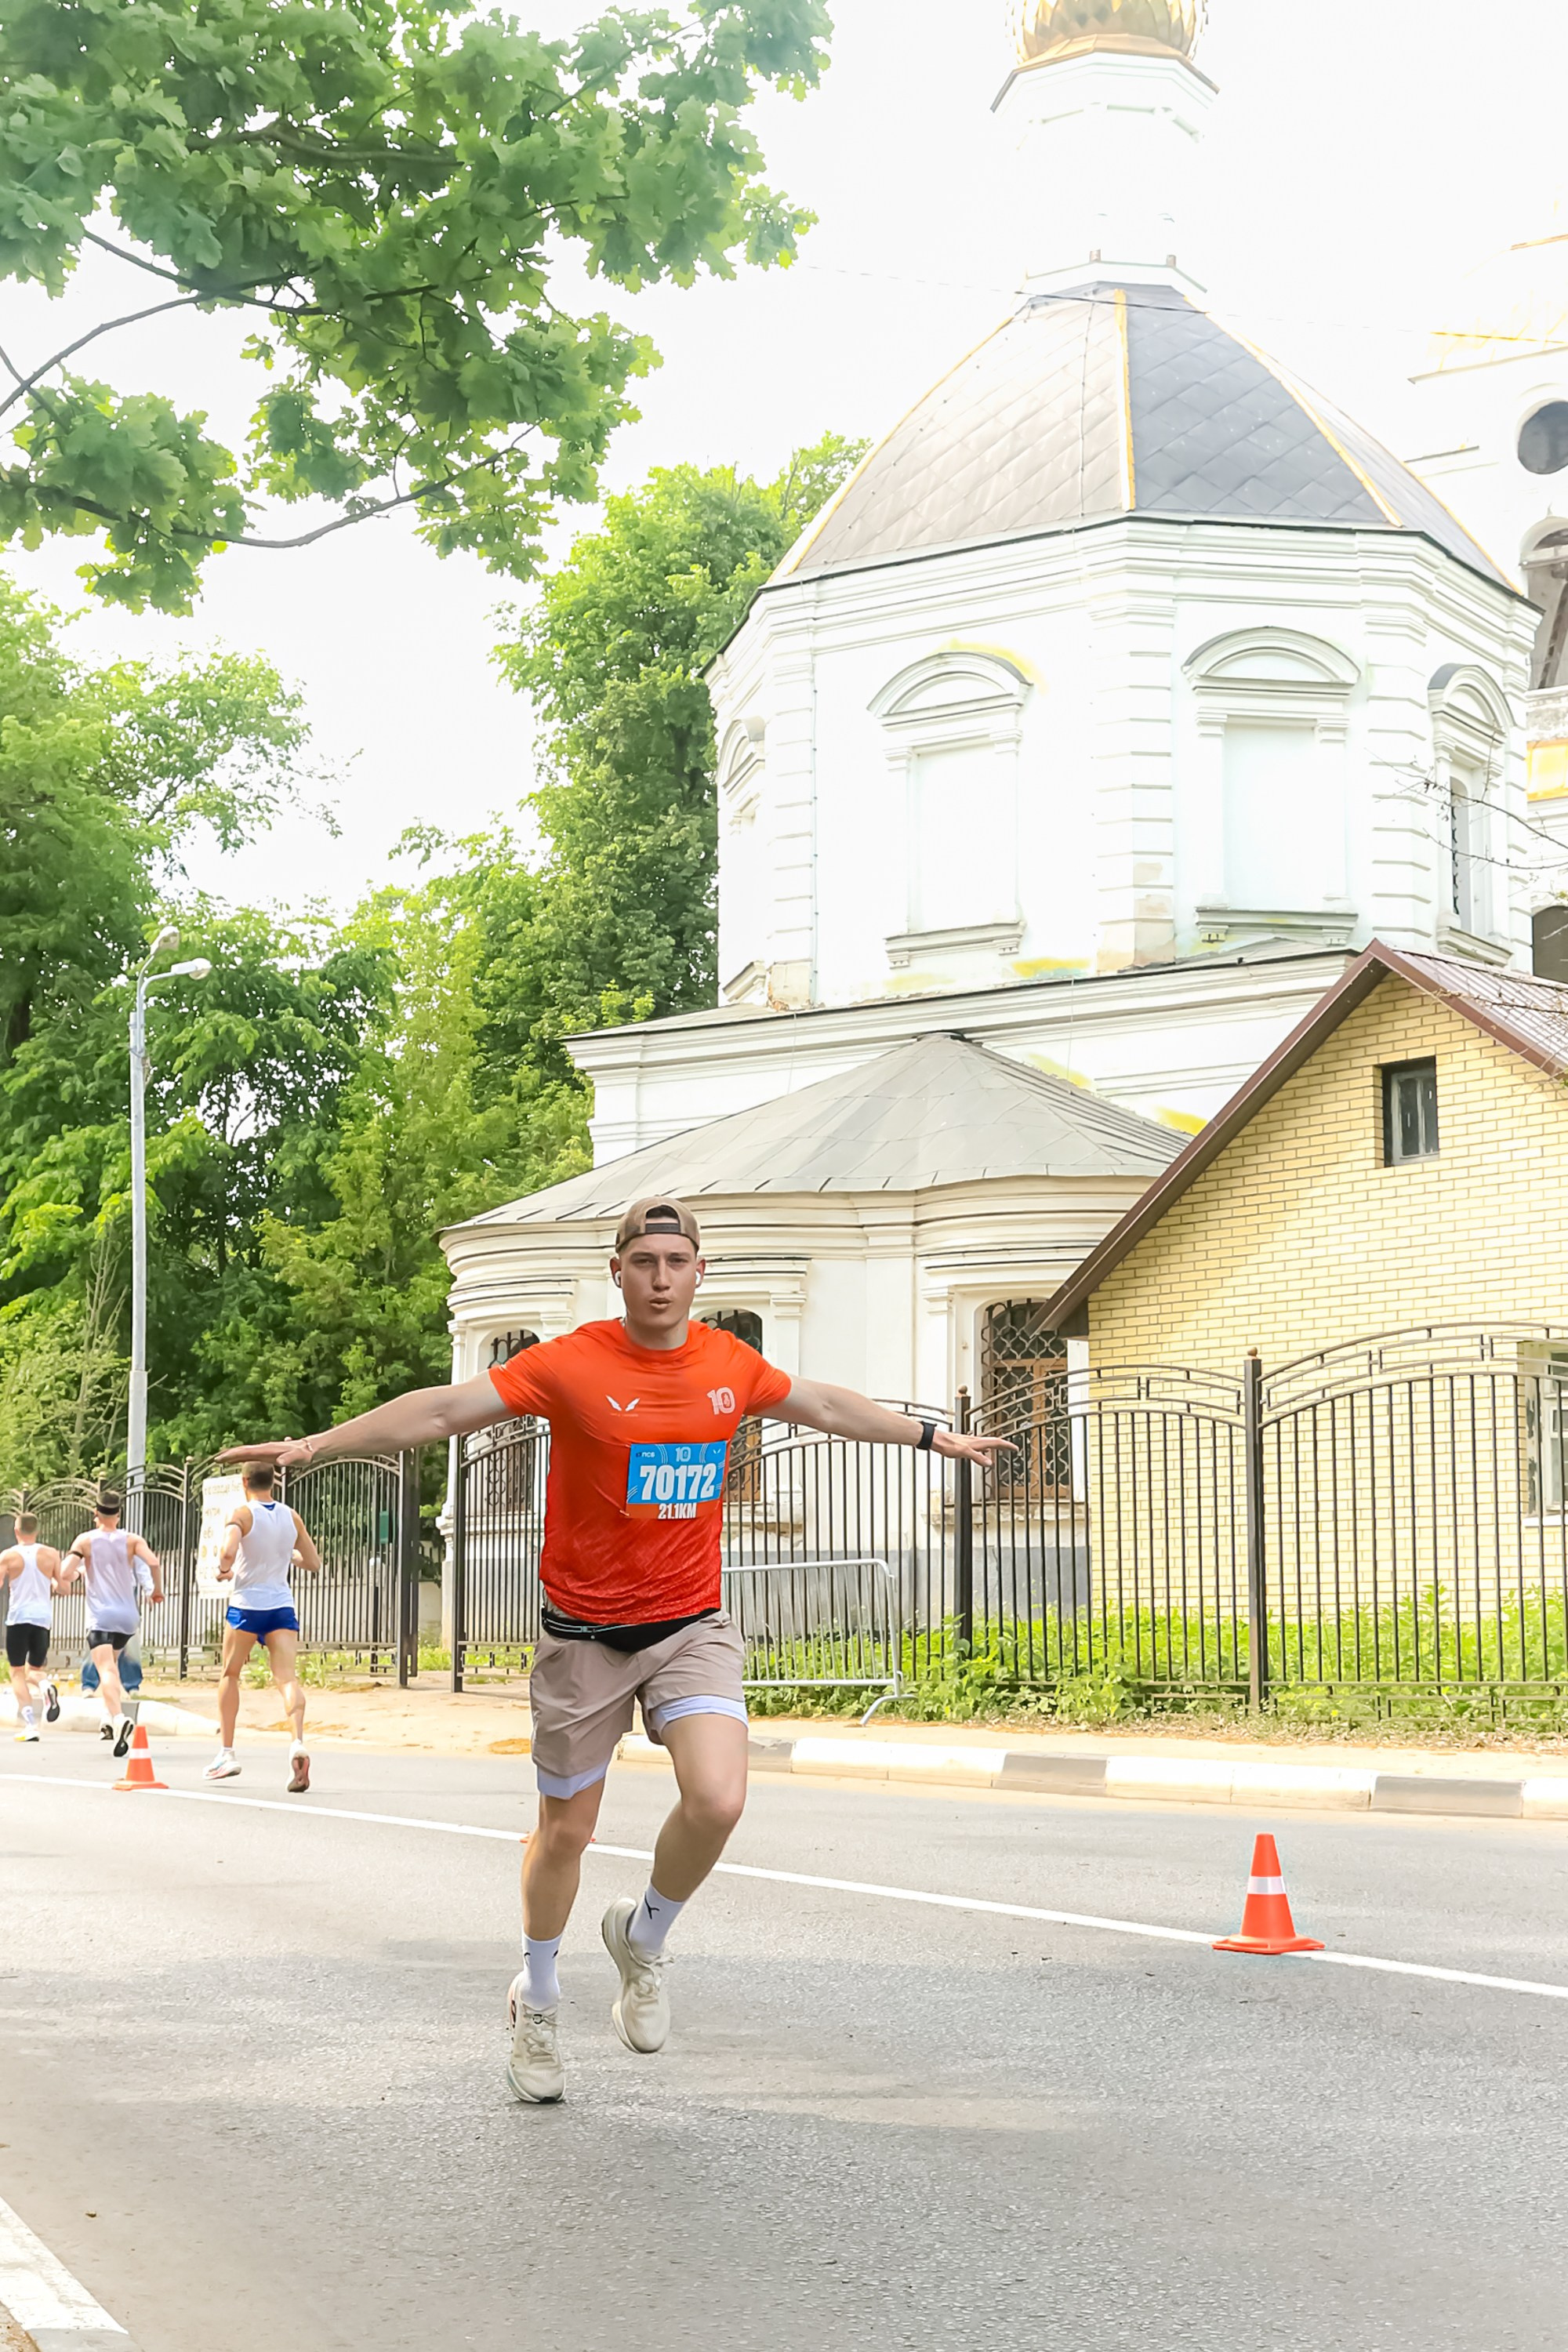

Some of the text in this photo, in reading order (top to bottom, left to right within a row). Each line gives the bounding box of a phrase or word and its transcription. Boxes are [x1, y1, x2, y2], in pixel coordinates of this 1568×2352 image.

[706, 1387, 735, 1415] 10
[675, 1446, 691, 1462] 10
[640, 1463, 717, 1501] 70172
[658, 1502, 698, 1519] 21.1KM
